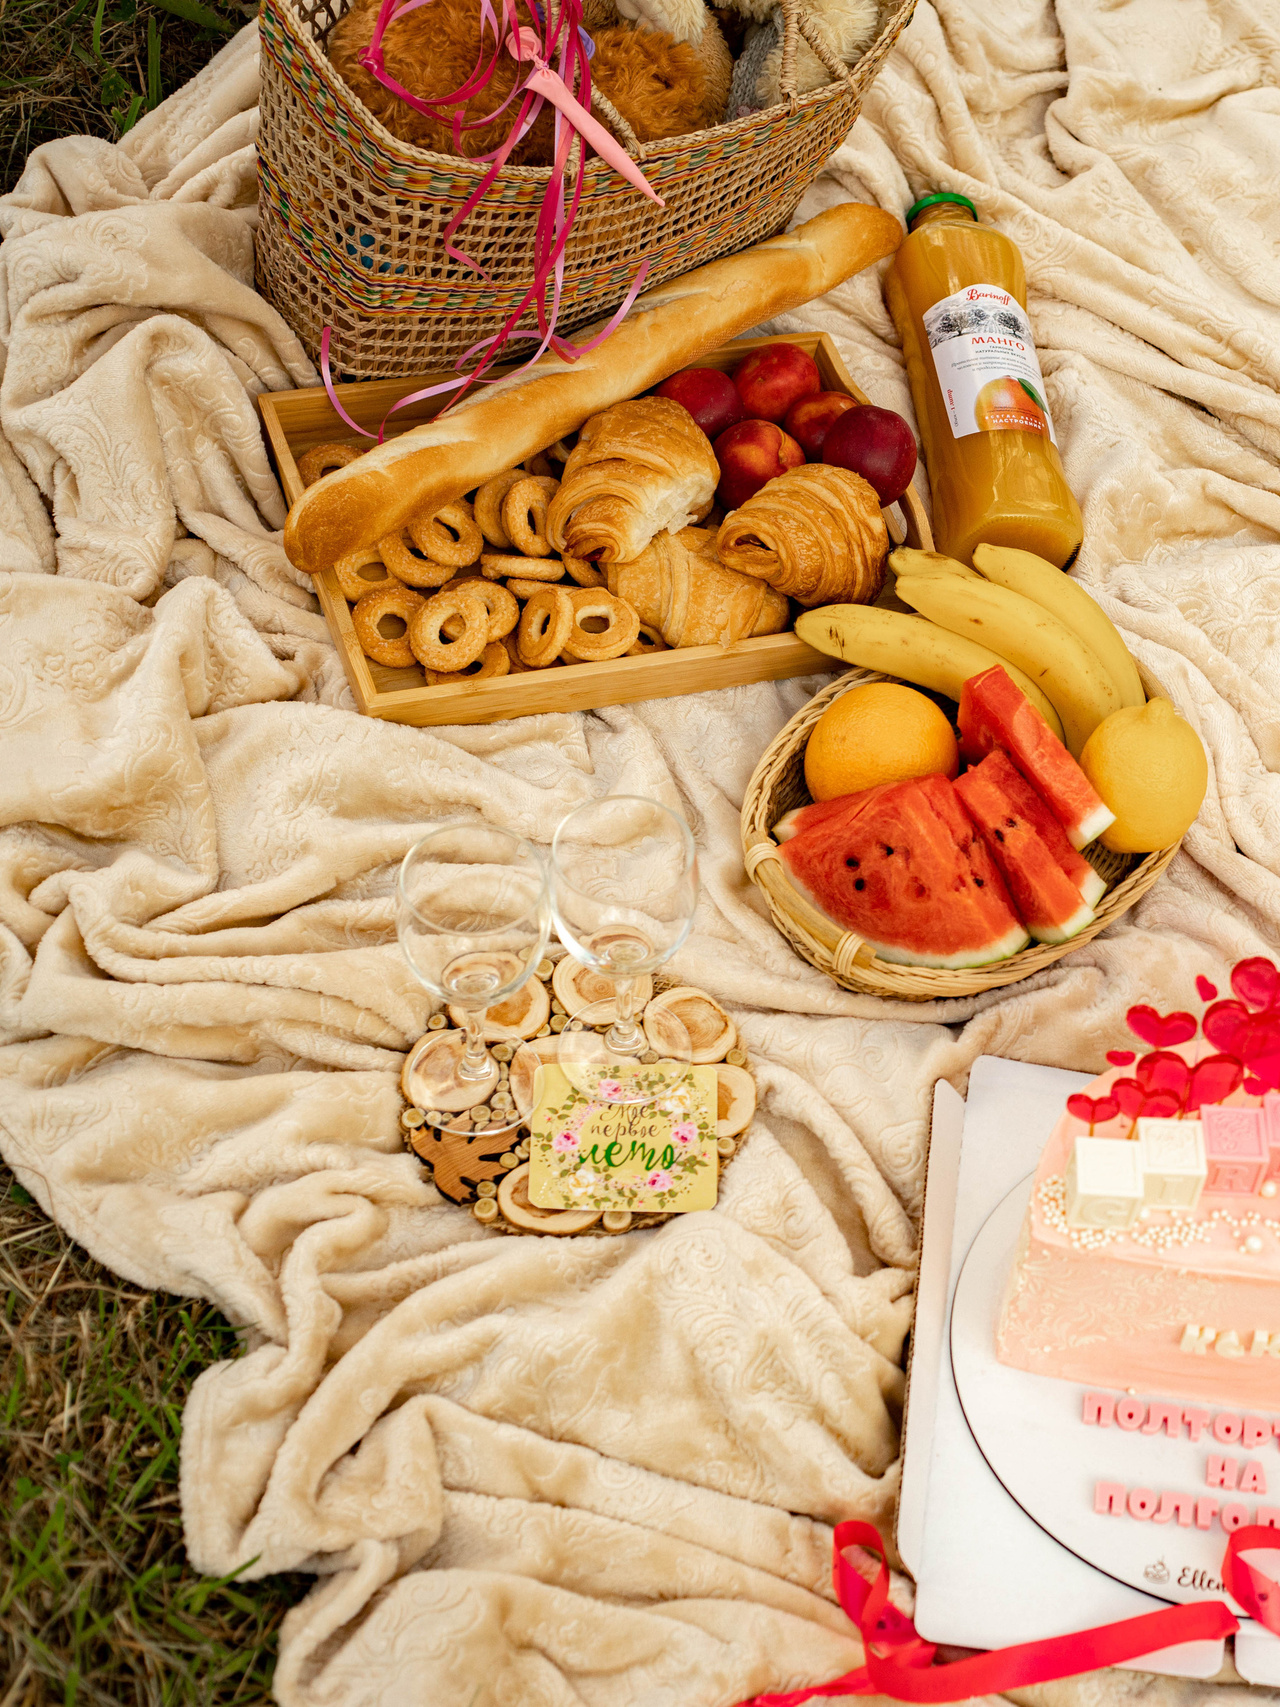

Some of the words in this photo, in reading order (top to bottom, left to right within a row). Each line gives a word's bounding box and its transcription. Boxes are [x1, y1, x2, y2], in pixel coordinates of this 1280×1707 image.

[966, 288, 1011, 306] Barinoff
[971, 336, 1025, 351] МАНГО
[992, 418, 1041, 430] НАСТРОЕНИЕ
[591, 1115, 660, 1142] первое
[578, 1140, 682, 1171] лето
[1205, 1454, 1268, 1495] НА
[1178, 1566, 1228, 1593] Ellen
